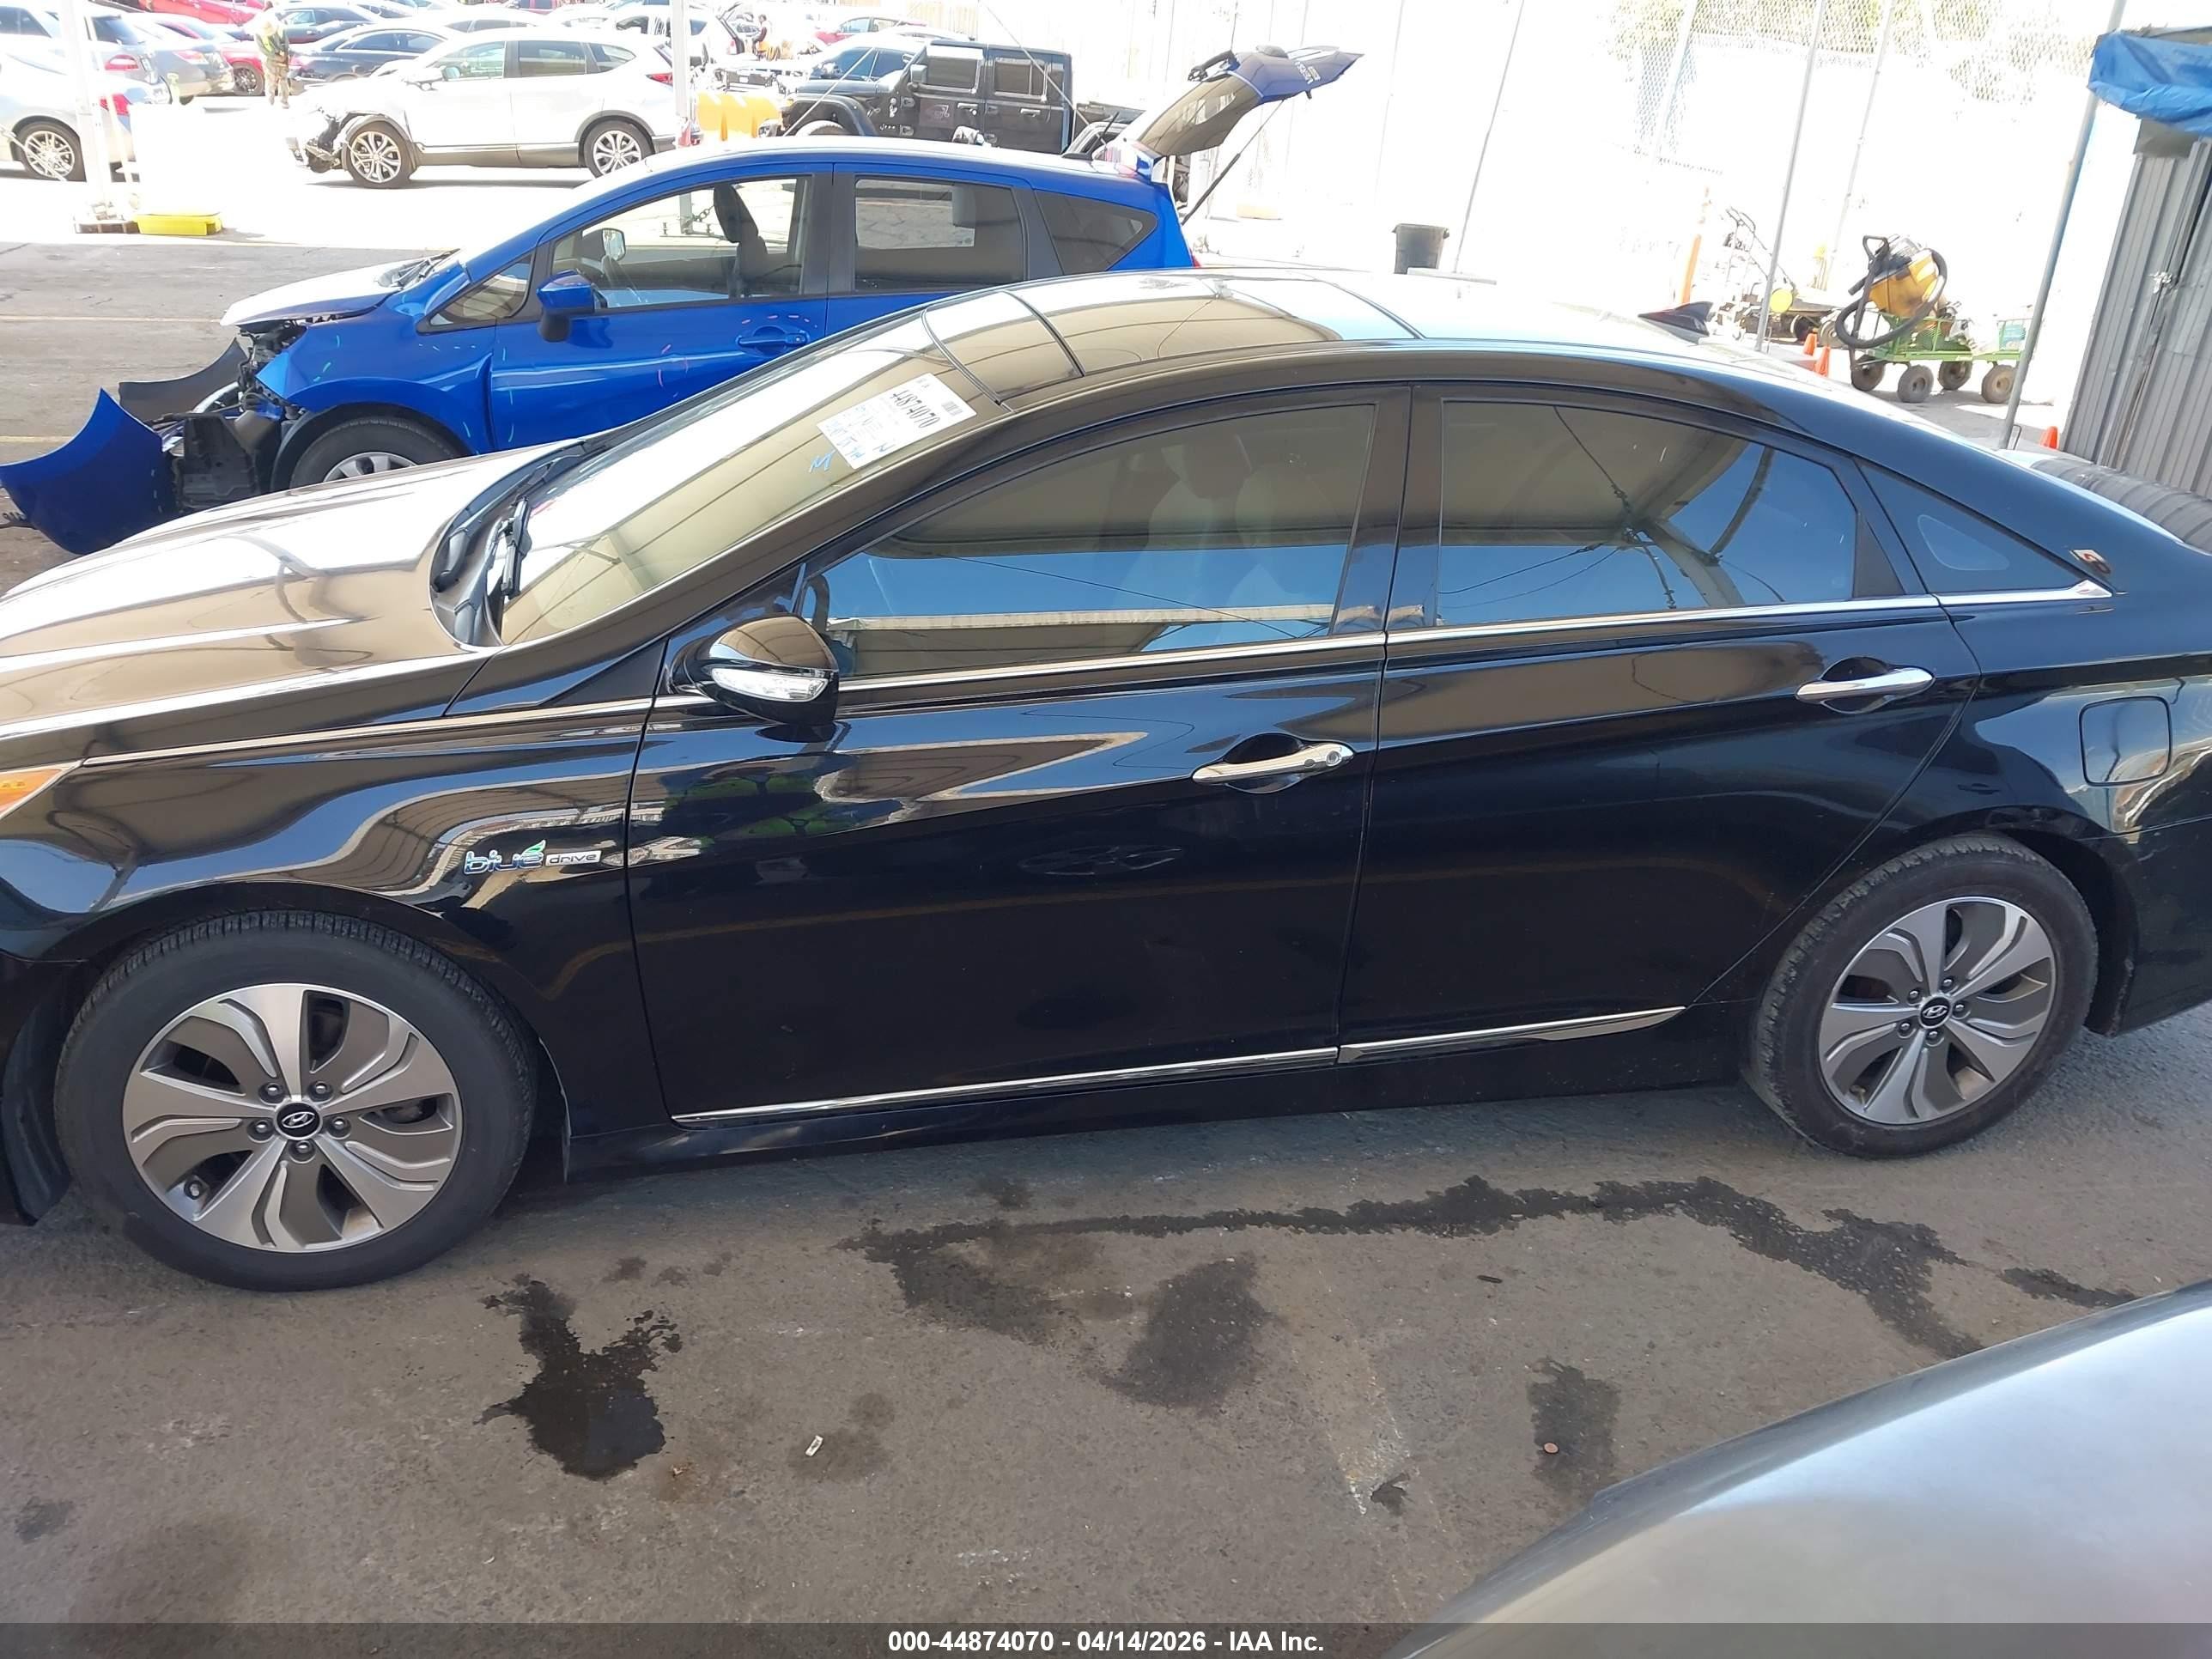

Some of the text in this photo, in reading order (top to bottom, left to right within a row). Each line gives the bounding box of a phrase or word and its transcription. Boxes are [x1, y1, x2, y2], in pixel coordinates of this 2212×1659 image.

[890, 389, 941, 428] 44874070
[464, 848, 599, 875] blue drive
